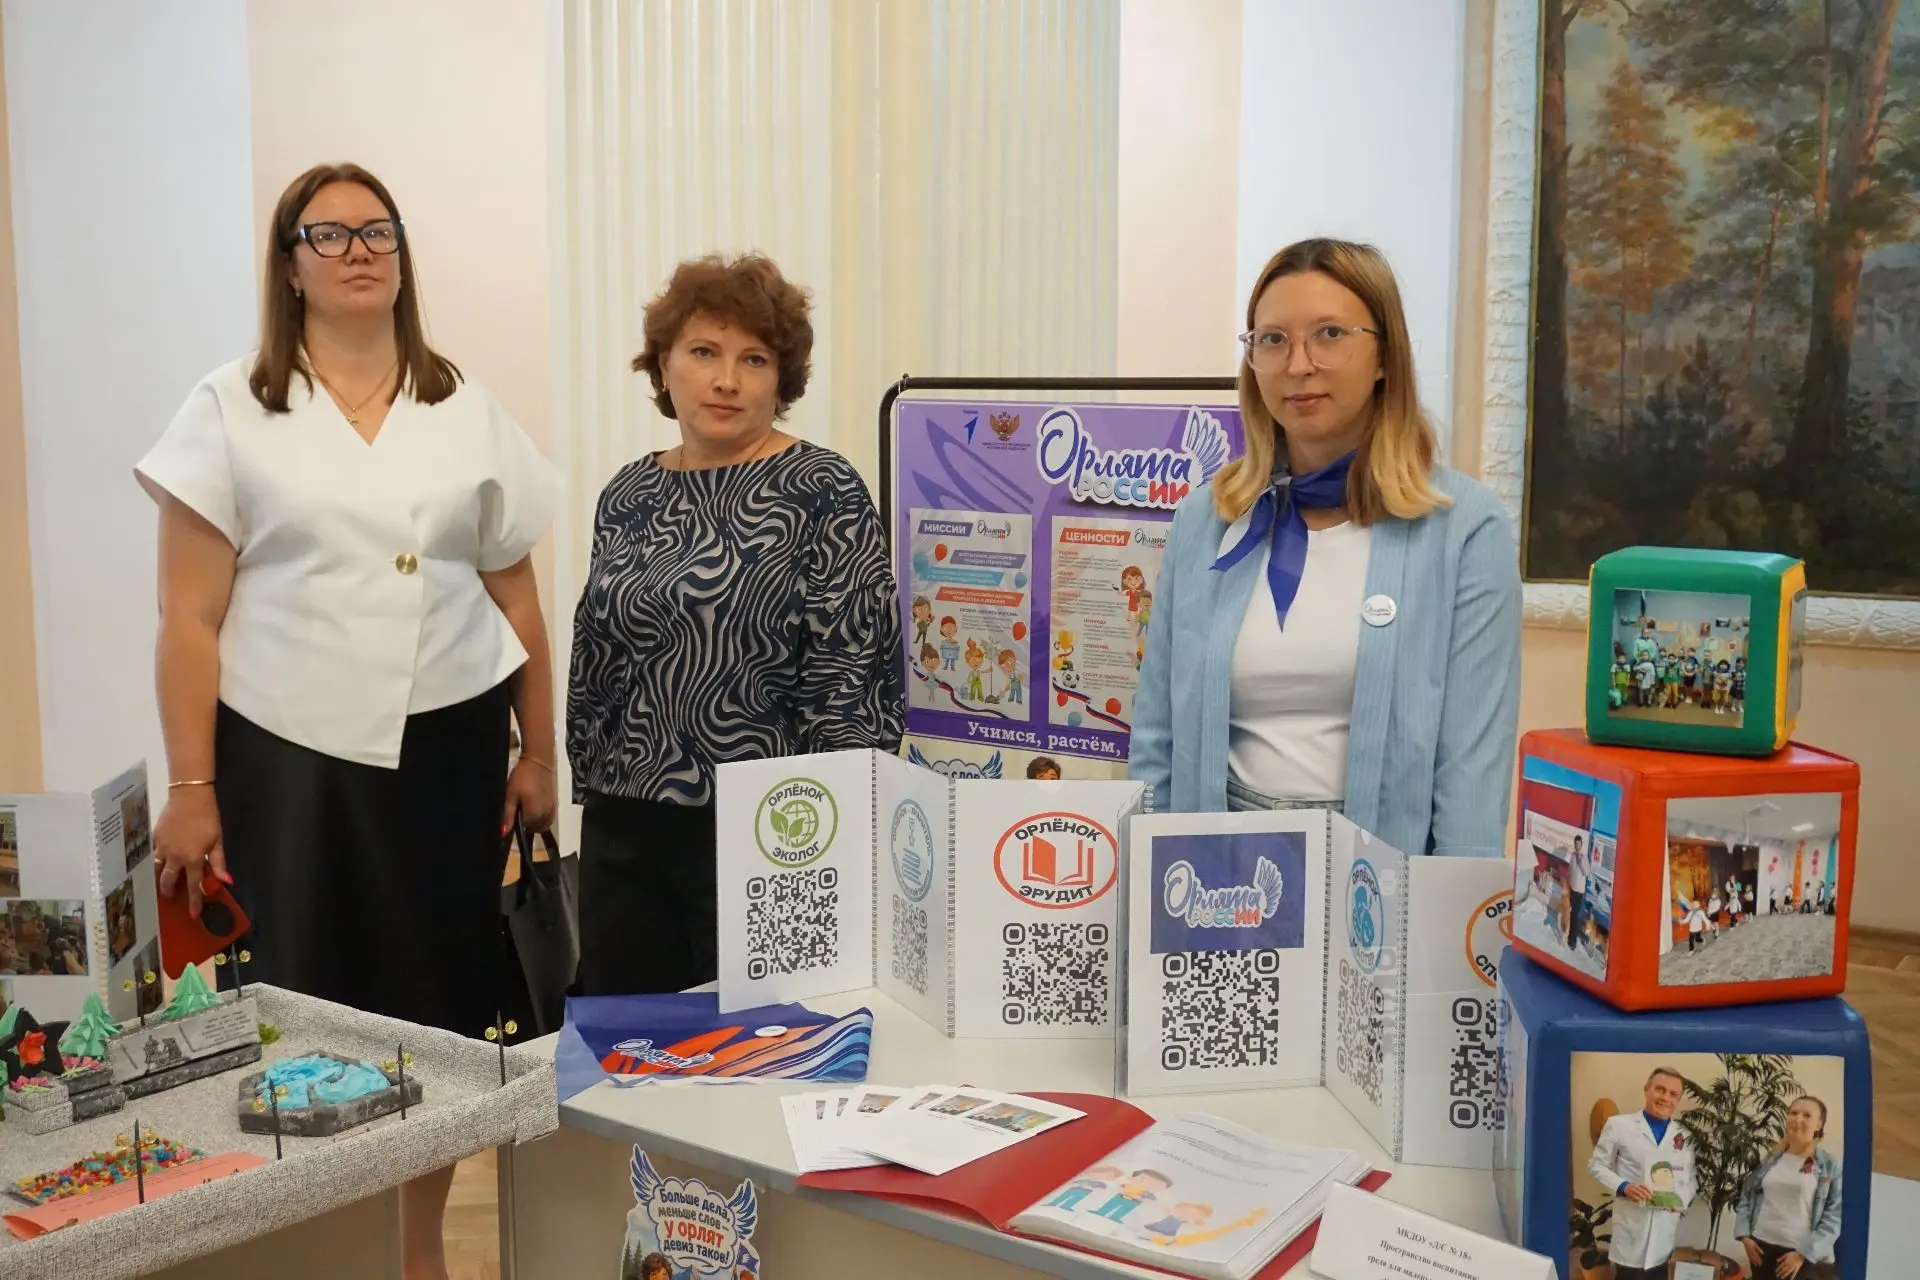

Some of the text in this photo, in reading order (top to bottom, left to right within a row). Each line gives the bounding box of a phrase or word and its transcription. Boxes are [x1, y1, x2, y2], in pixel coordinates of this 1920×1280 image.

[1041, 410, 1192, 488] Орлята
[924, 523, 966, 535] МИССИИ
[1065, 531, 1125, 544] ЦЕННОСТИ
[967, 721, 1121, 756] Учимся, растём,
[768, 783, 825, 806] ОРЛЁНОК
[1015, 818, 1102, 842] ОРЛЁНОК
[772, 841, 820, 862] ЭКОЛОГ
[1019, 885, 1093, 903] ЭРУДИТ
[1166, 863, 1262, 919] Орлята
[1352, 867, 1380, 901] ОРЛЁНОК
[660, 1188, 730, 1222] Больше дела,
[658, 1207, 697, 1220] меньше
[698, 1212, 721, 1230] слов
[678, 1221, 724, 1248] орлят
[663, 1239, 730, 1265] девиз таков!
[1380, 1240, 1431, 1265] Пространство
[1388, 1263, 1402, 1273] для
